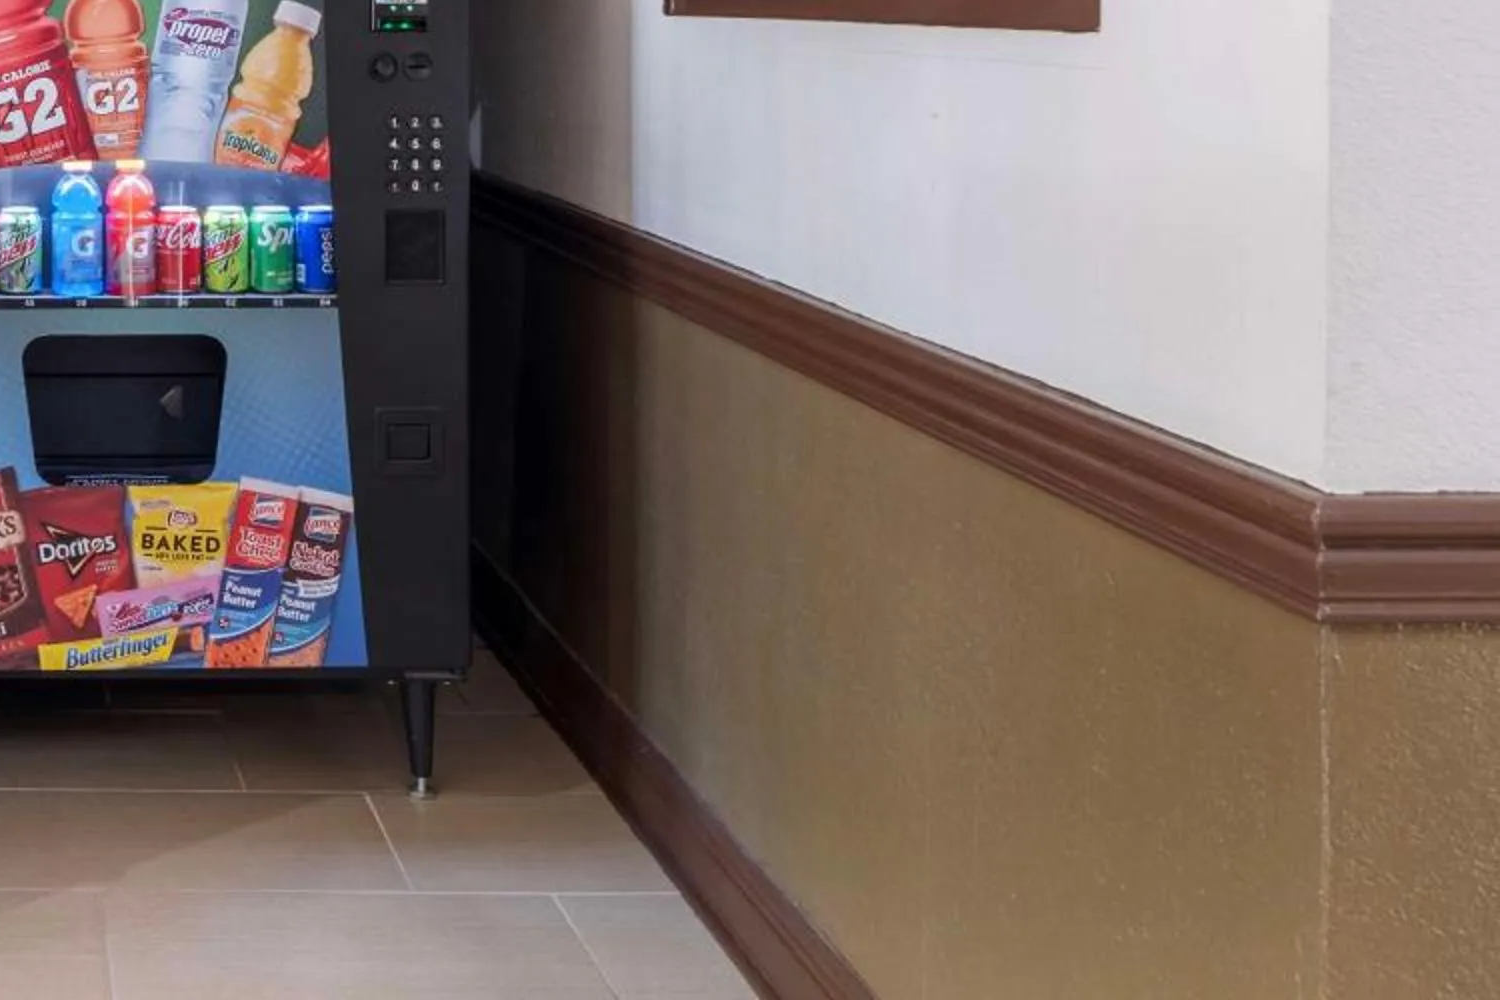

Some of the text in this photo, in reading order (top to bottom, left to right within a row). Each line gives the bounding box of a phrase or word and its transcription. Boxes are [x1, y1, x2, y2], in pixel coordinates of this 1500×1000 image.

[169, 20, 231, 47] propel
[87, 78, 139, 115] G2
[391, 117, 398, 129] 1
[411, 117, 420, 128] 2
[222, 132, 279, 165] Tropicana
[73, 231, 96, 256] G
[38, 536, 116, 563] Doritos
[141, 533, 221, 553] BAKED
[226, 579, 263, 599] Peanut
[223, 593, 257, 608] Butter
[280, 592, 316, 612] Peanut
[278, 607, 310, 622] Butter
[66, 632, 168, 670] Butterfinger
